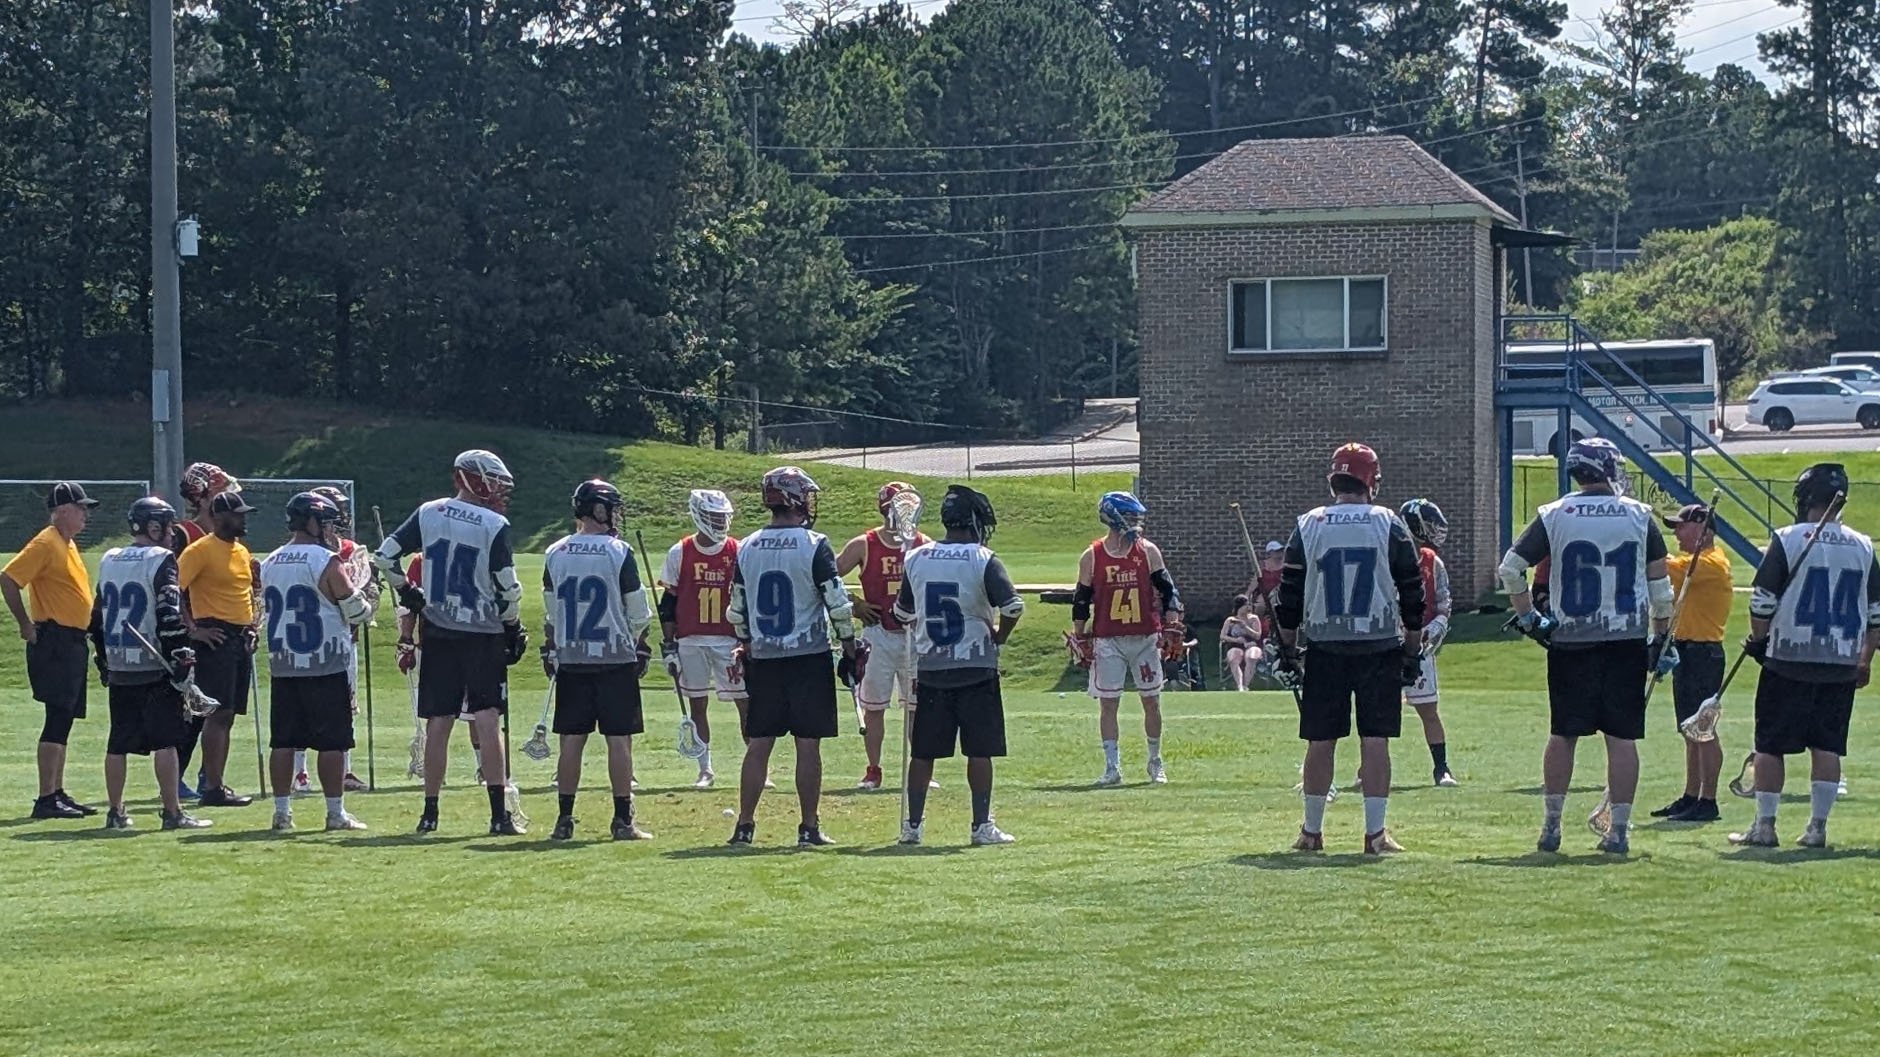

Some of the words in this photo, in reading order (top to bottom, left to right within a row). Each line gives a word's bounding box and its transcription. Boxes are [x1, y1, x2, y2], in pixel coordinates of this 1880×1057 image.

[446, 506, 482, 525] TPAAA
[760, 537, 797, 548] TPAAA
[1326, 513, 1371, 524] TPAAA
[1576, 504, 1627, 515] TPAAA
[425, 537, 480, 609] 14
[568, 543, 606, 554] TPAAA
[929, 549, 970, 560] TPAAA
[1560, 540, 1639, 617] 61
[102, 581, 148, 648] 22
[557, 575, 610, 641] 12
[698, 587, 721, 624] 11
[756, 570, 796, 637] 9
[925, 581, 965, 648] 5
[1110, 588, 1141, 625] 41
[1316, 548, 1377, 617] 17
[1794, 566, 1864, 641] 44
[264, 584, 324, 654] 23
